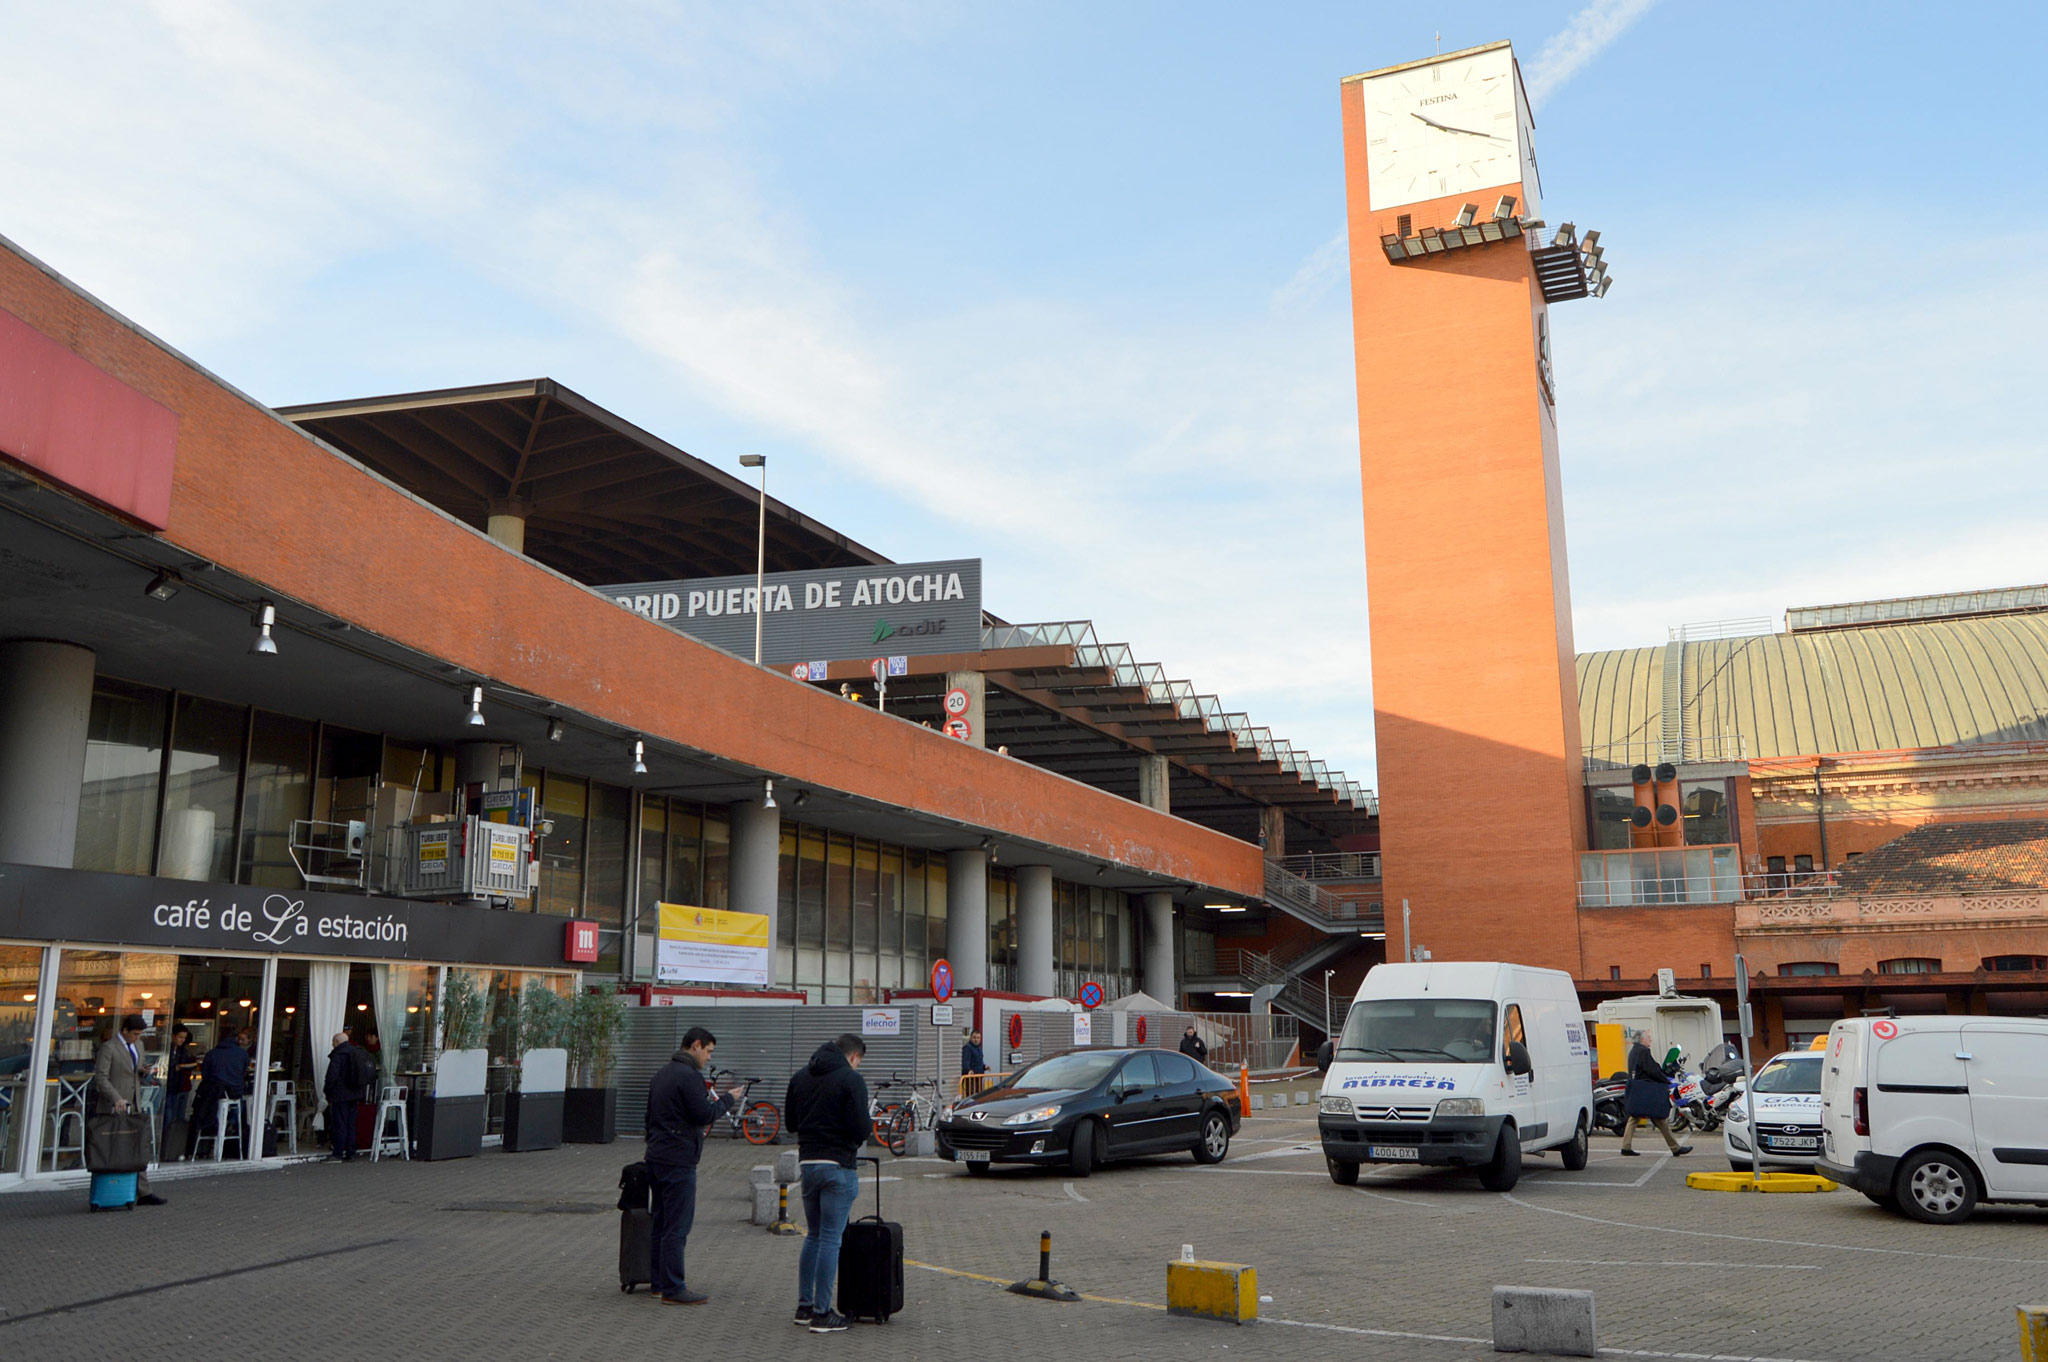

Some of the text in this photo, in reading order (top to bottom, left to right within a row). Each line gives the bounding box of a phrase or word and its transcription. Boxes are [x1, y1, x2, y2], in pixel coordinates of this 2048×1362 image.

[1420, 93, 1458, 107] FESTINA
[688, 584, 794, 618] PUERTA
[805, 580, 842, 610] DE
[851, 572, 965, 607] ATOCHA
[897, 619, 946, 636] adif
[949, 696, 964, 708] 20
[486, 794, 512, 803] GEDA
[421, 861, 444, 869] GEDA
[491, 862, 513, 871] GEDA
[153, 894, 408, 945] café de La estación
[865, 1018, 897, 1029] elecnor
[1342, 1078, 1456, 1091] ALBRESA
[1773, 1137, 1815, 1146] 7522 JKP
[958, 1151, 975, 1160] 2155
[1374, 1148, 1417, 1158] 4004 DXX
